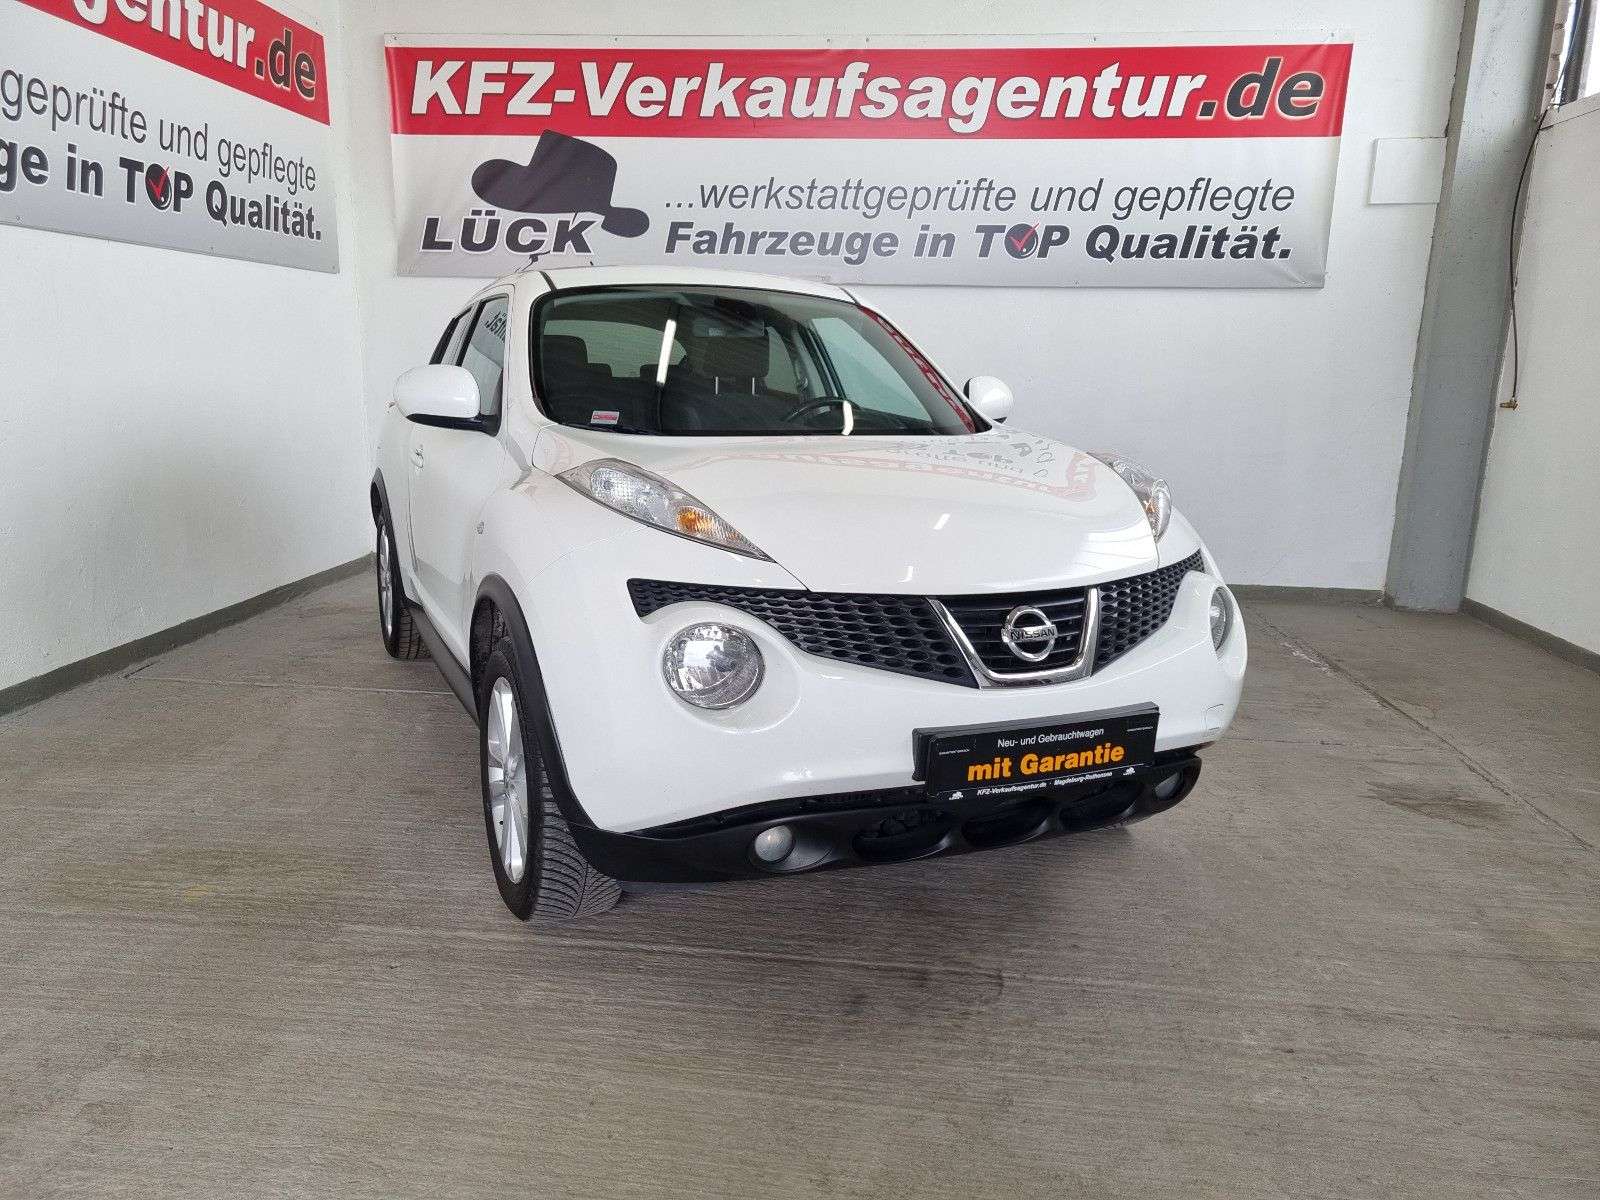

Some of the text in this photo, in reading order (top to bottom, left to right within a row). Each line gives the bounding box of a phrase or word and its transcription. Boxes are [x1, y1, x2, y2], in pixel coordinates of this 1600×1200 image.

[411, 57, 1325, 134] KFZ-Verkaufsagentur.de
[159, 118, 208, 161] und
[217, 137, 316, 195] gepflegte
[66, 143, 103, 197] in
[119, 157, 194, 212] TOP
[205, 180, 321, 240] Qualität.
[664, 177, 1295, 220] ...werkstattgeprüfte und gepflegte
[421, 209, 595, 253] LÜCK
[665, 222, 1292, 266] Fahrzeuge in TOP Qualität.
[1011, 628, 1055, 640] NISSAN
[997, 728, 1105, 748] Neu- und Gebrauchtwagen
[968, 742, 1125, 782] mit Garantie
